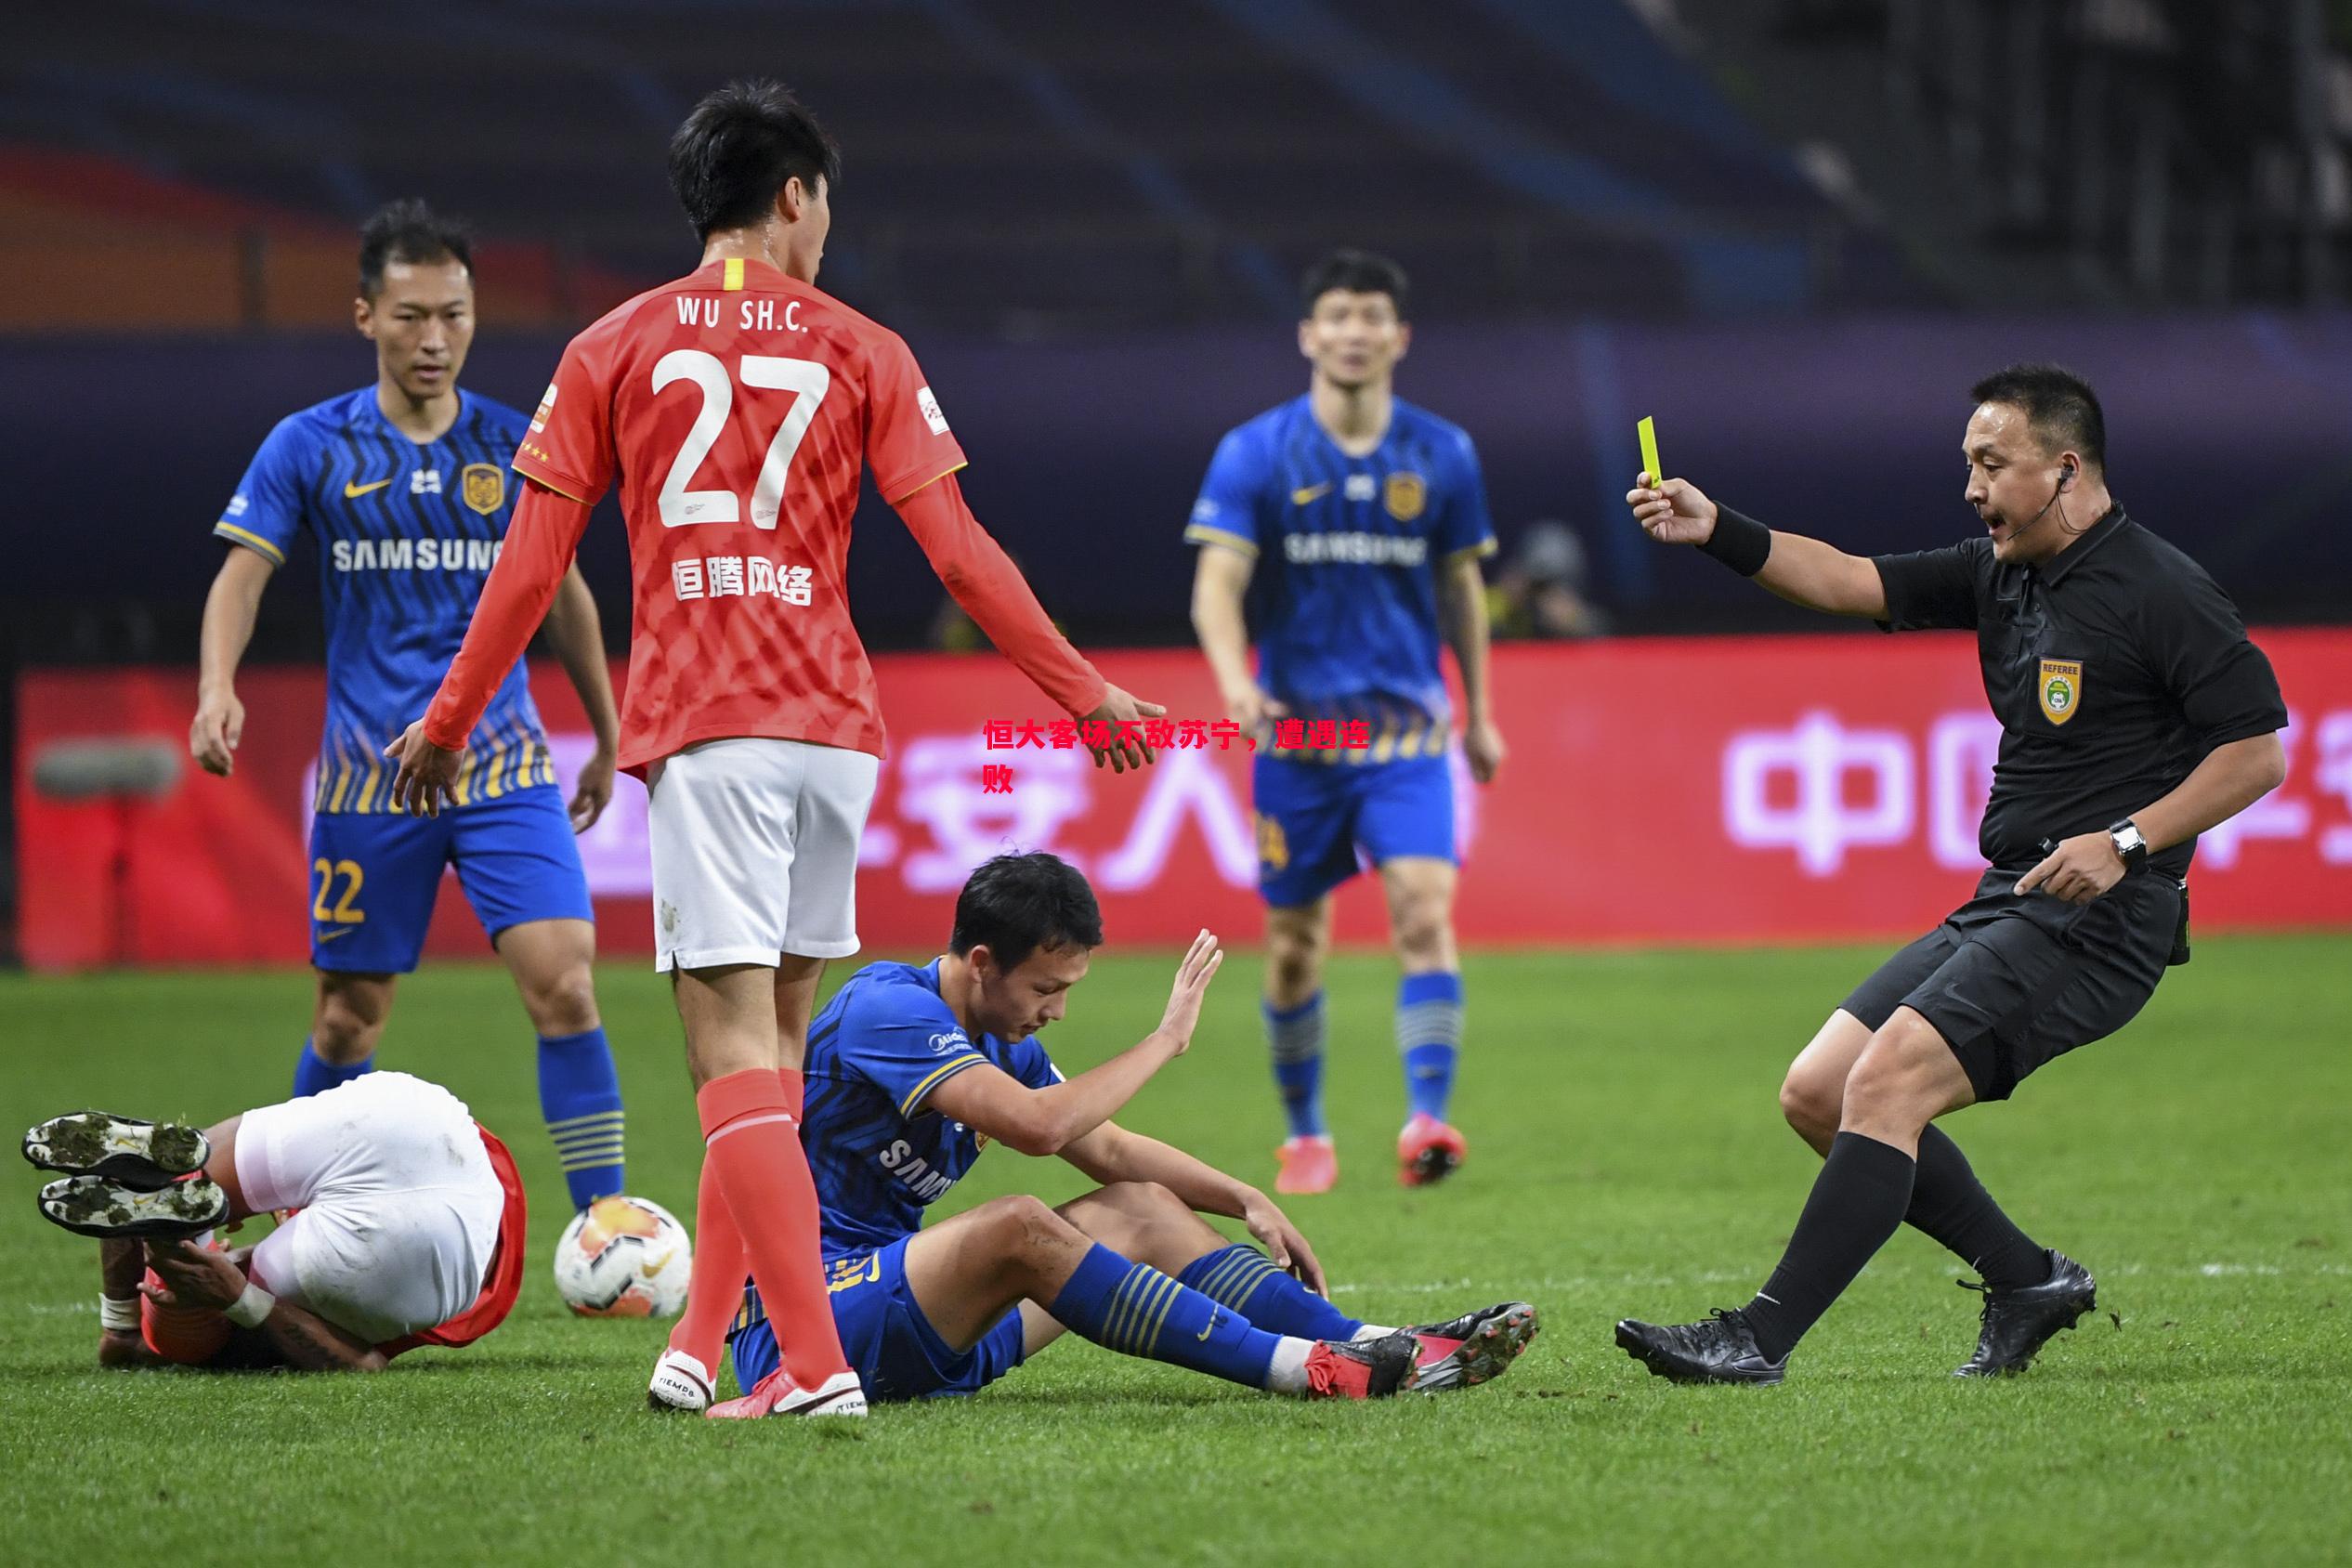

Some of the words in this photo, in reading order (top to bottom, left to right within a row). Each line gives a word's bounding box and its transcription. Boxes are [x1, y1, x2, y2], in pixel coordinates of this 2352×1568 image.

[675, 295, 720, 328] WU
[739, 300, 808, 333] SH.C.
[651, 348, 830, 529] 27
[672, 555, 813, 607] 恒腾网络
[2043, 663, 2079, 675] REFEREE
[313, 857, 365, 923] 22
[879, 1139, 957, 1202] SAM
[660, 1377, 695, 1397] TIEMPO
